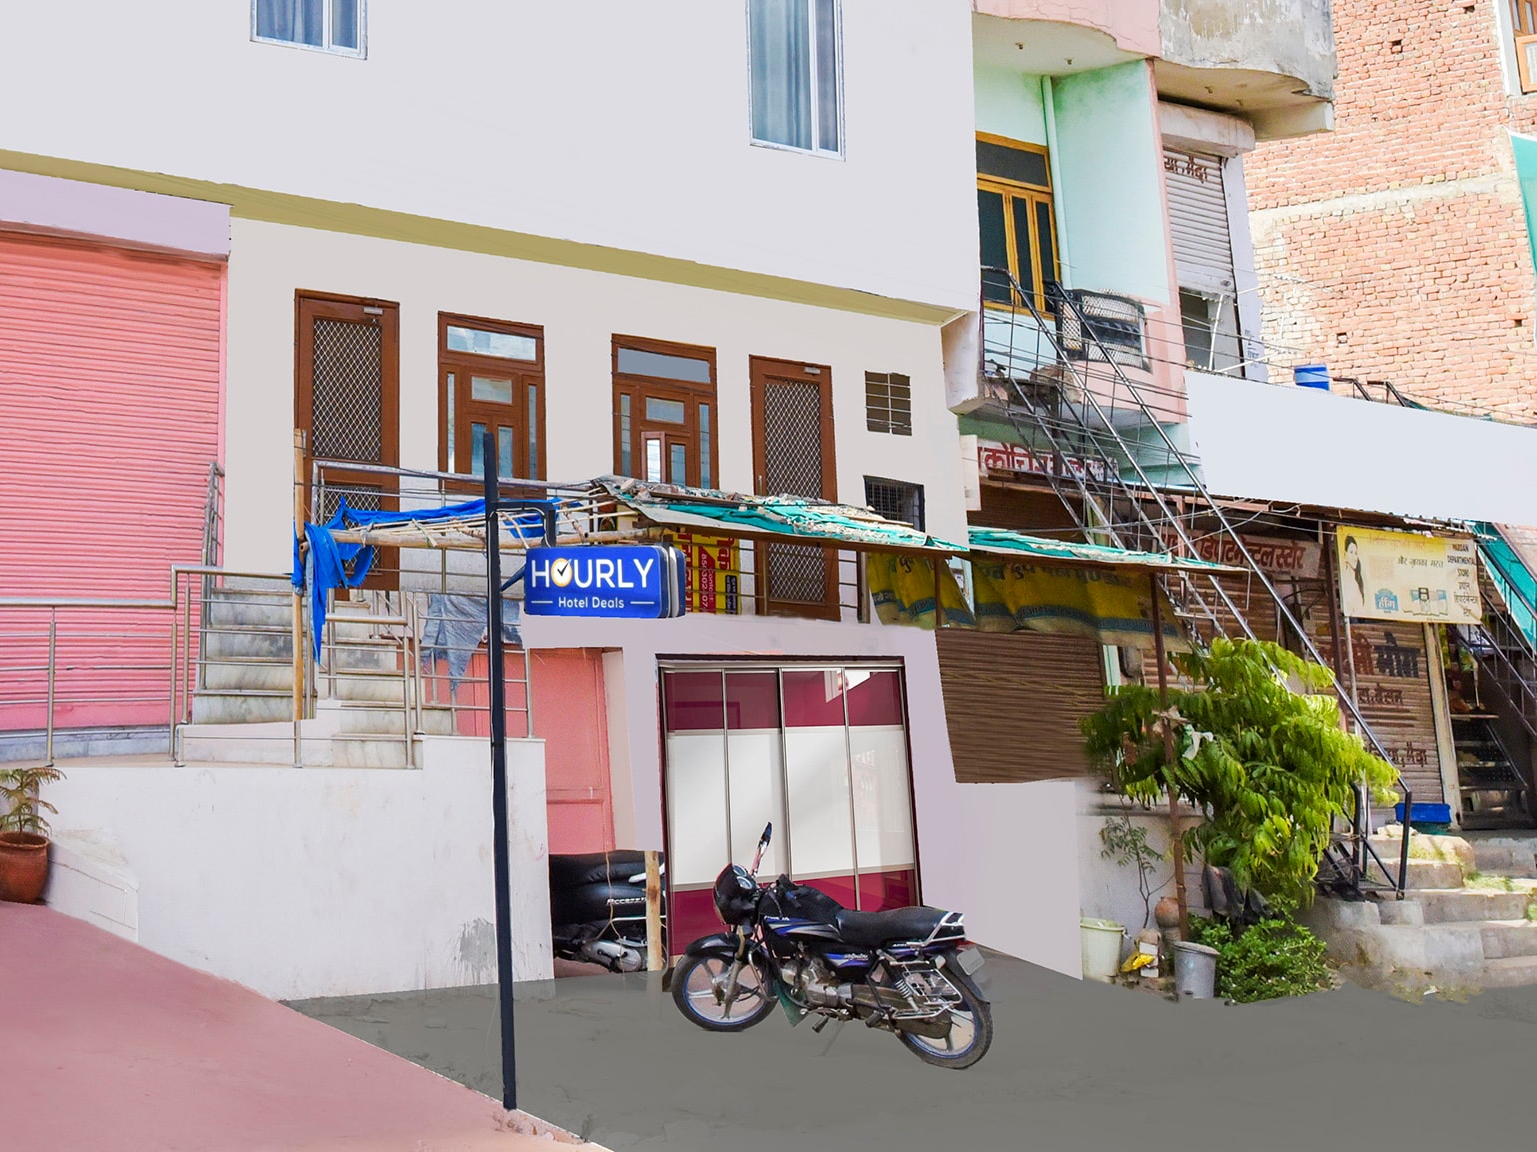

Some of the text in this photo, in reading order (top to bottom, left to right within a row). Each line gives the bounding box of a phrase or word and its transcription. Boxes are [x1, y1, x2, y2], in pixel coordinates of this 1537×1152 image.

[531, 557, 654, 589] HOURLY
[558, 596, 625, 609] Hotel Deals
